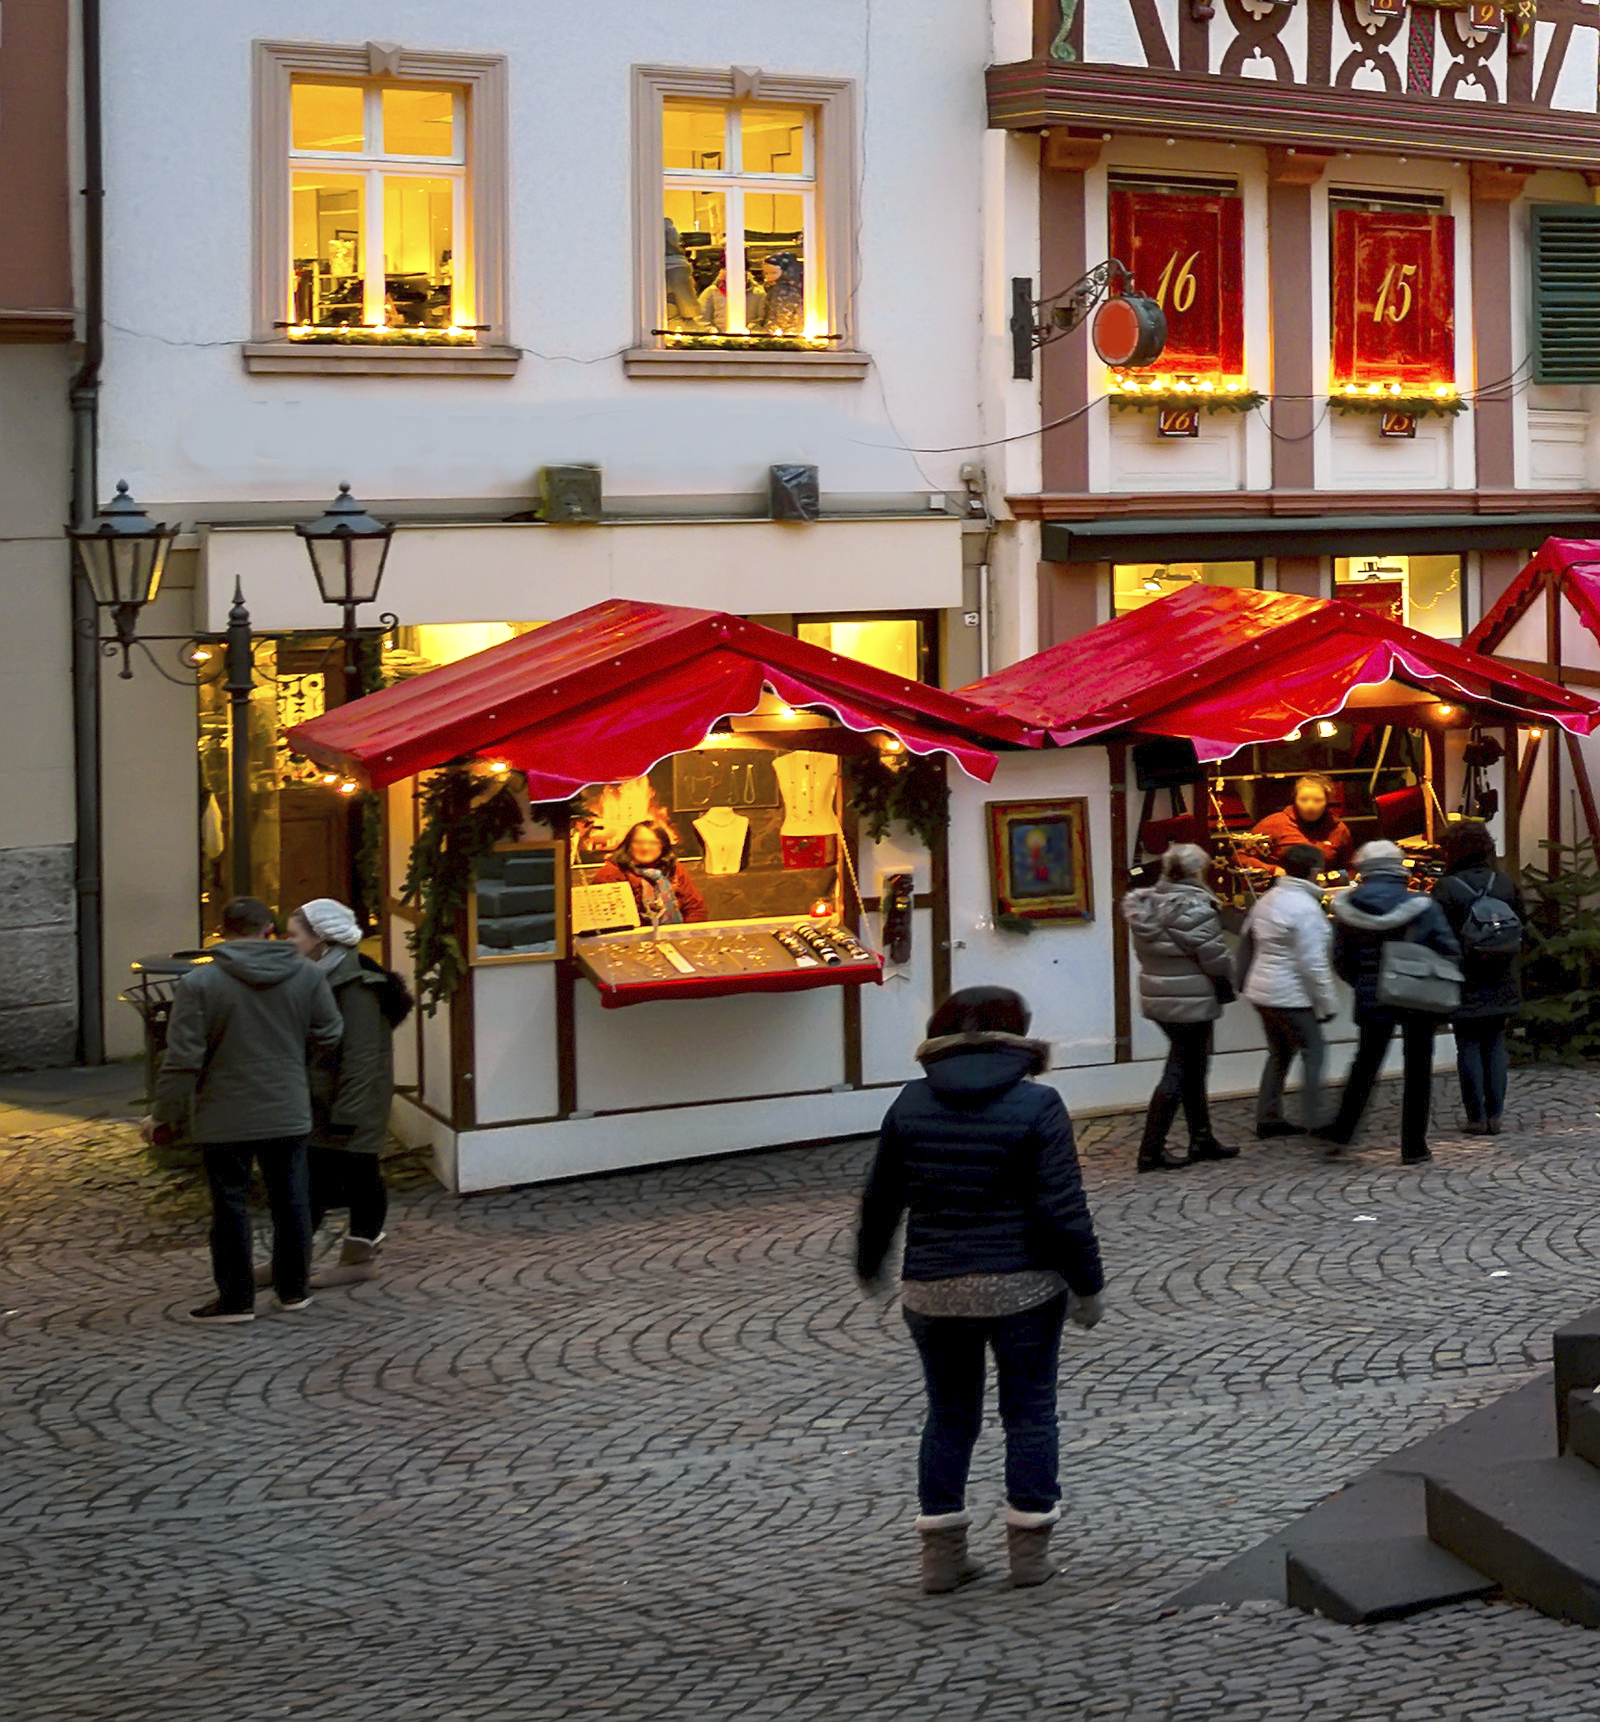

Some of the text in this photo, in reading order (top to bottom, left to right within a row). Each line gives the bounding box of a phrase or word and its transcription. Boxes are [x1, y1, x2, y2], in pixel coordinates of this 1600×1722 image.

[1480, 4, 1494, 22] 9
[1157, 251, 1417, 322] 16 15
[1163, 410, 1191, 430] 16
